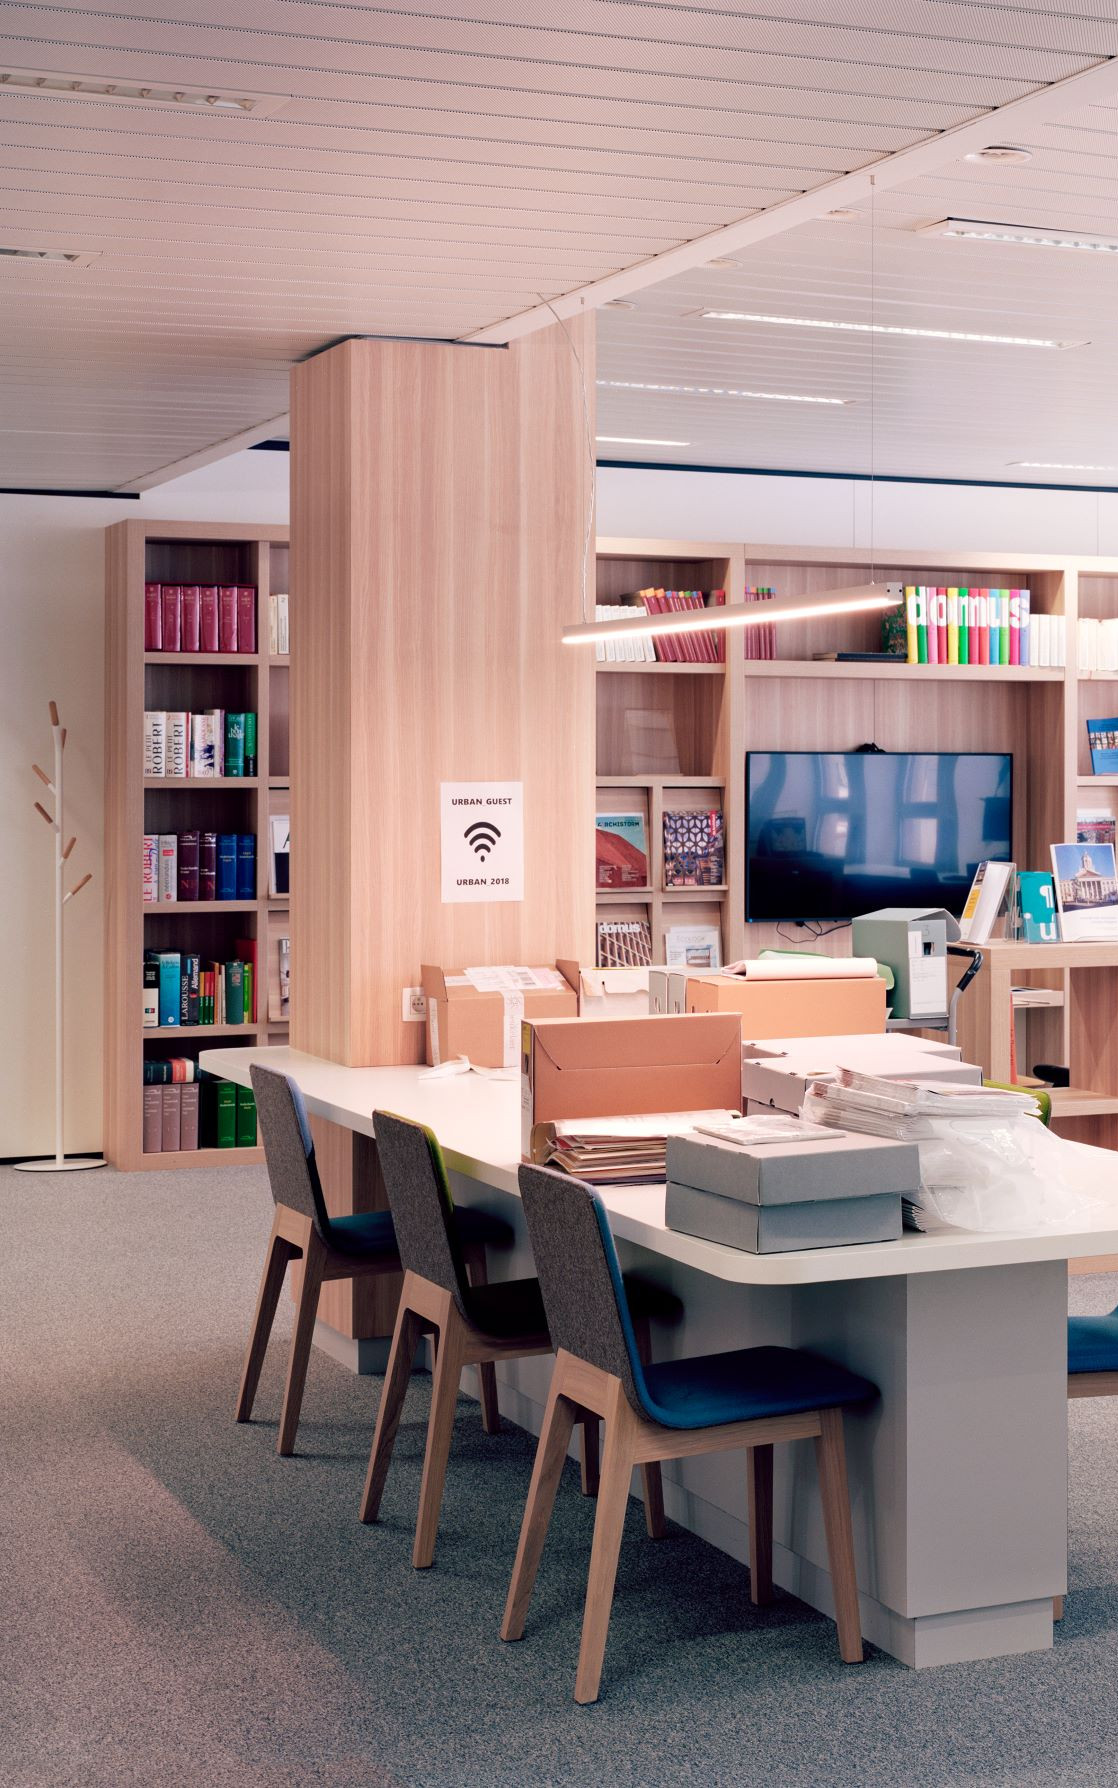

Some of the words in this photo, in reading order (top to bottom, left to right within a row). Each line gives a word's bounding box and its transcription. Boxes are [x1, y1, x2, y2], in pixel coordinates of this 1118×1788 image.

[905, 586, 1030, 628] domus
[152, 721, 163, 774] ROBERT
[173, 723, 184, 775] ROBERT
[599, 920, 641, 934] domus
[191, 958, 199, 990] Allemand
[181, 975, 189, 1020] LAROUSSE
